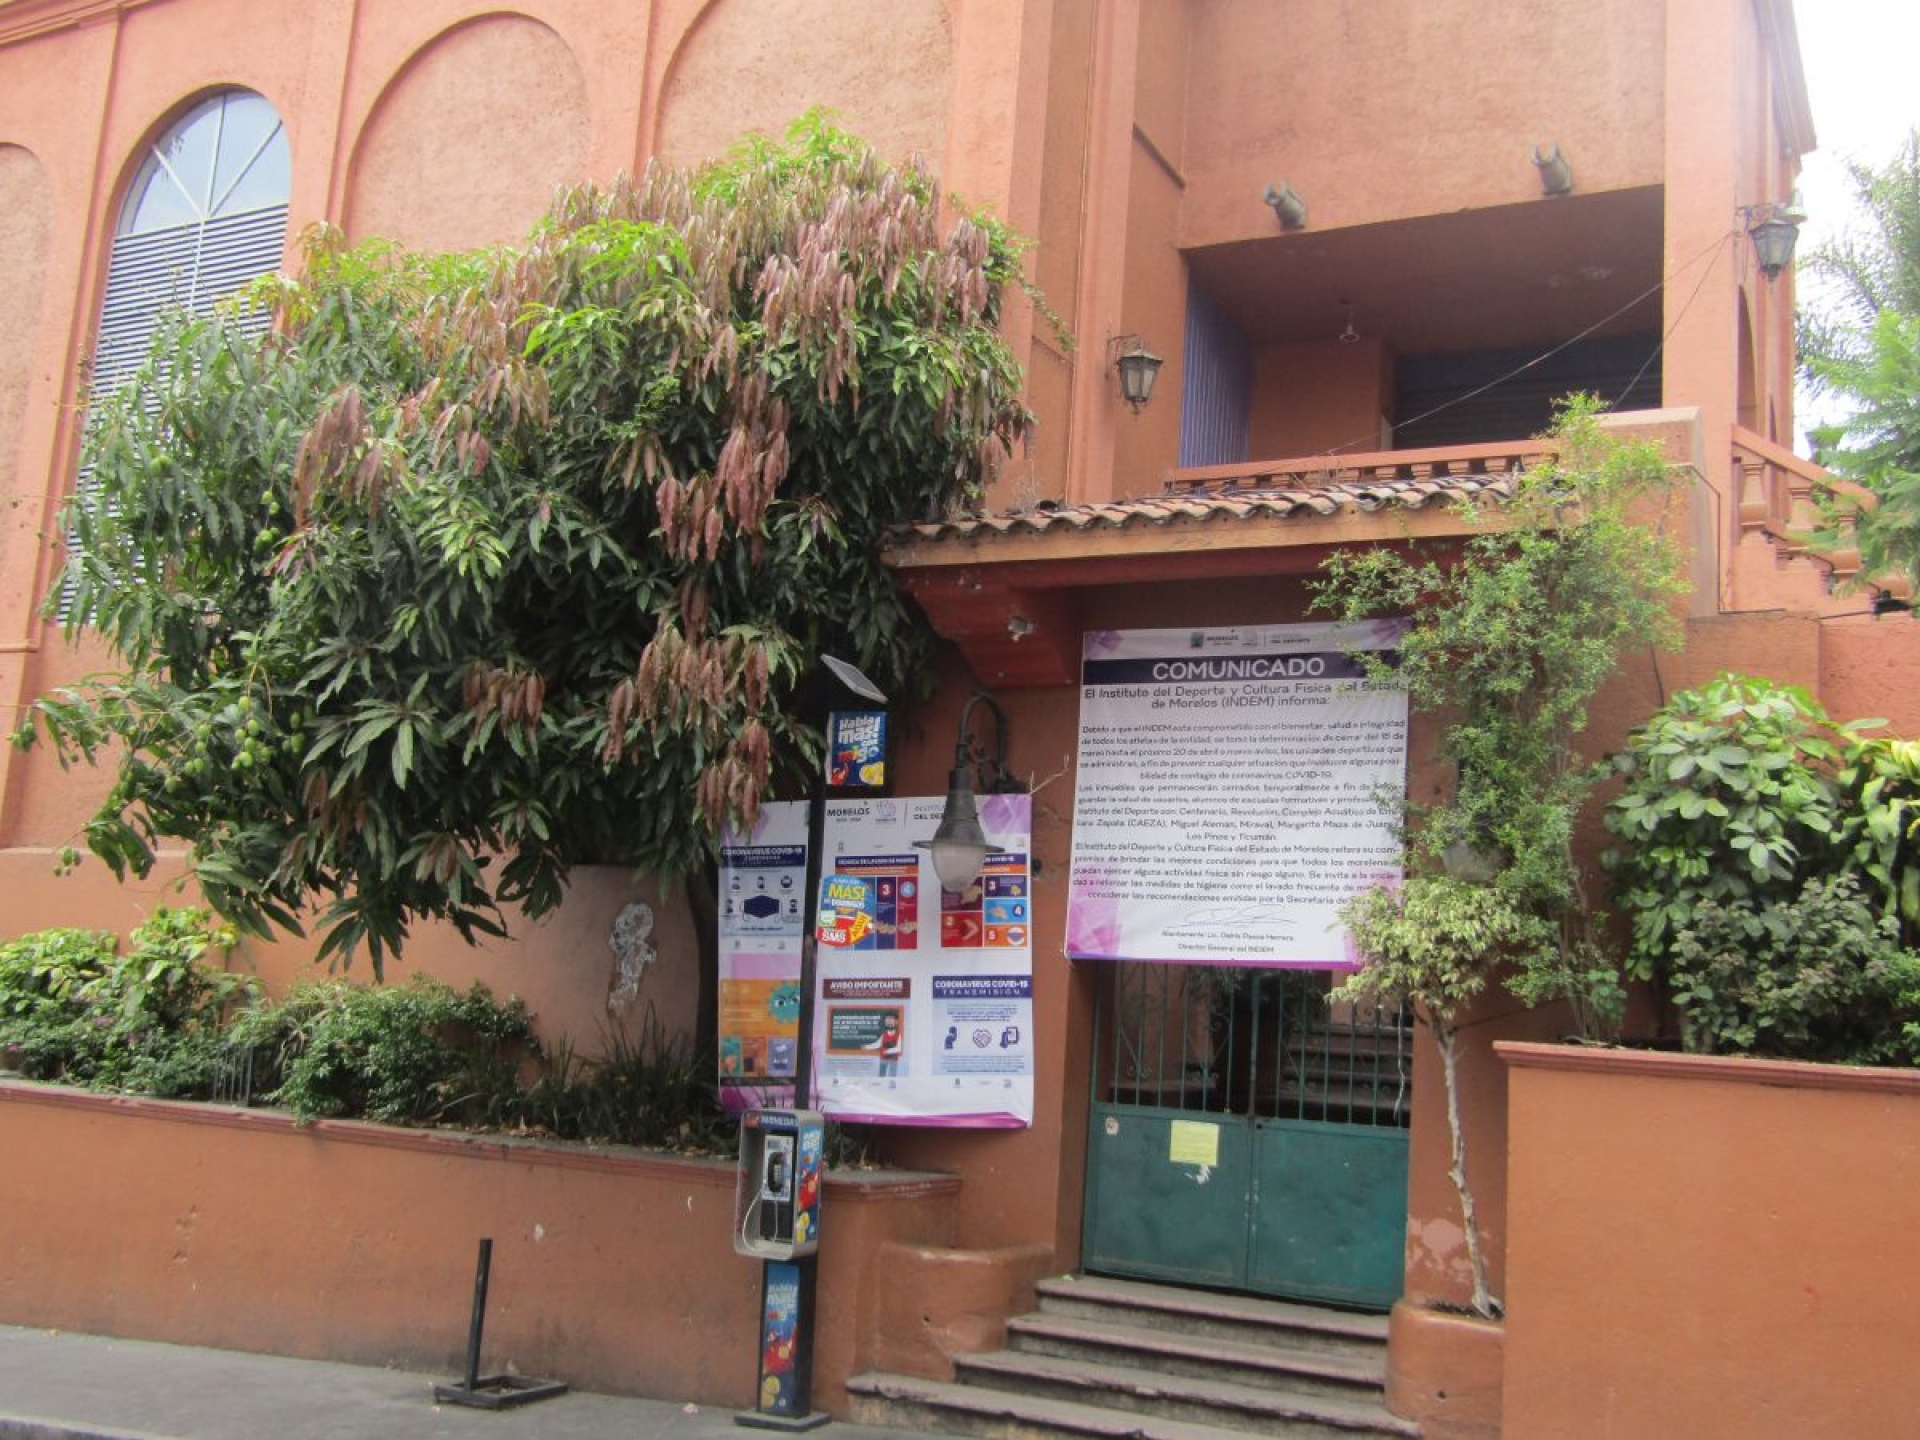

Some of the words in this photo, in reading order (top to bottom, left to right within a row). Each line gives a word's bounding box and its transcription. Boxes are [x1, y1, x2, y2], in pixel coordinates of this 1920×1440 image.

[1152, 657, 1326, 680] COMUNICADO
[1084, 688, 1096, 699] El
[1098, 686, 1150, 699] Instituto
[1152, 685, 1171, 697] del
[1174, 685, 1226, 699] Deporte
[1230, 687, 1239, 696] y
[1242, 683, 1290, 695] Cultura
[1151, 699, 1169, 710] de
[1170, 697, 1218, 708] Morelos
[1221, 695, 1275, 708] (INDEM)
[1278, 693, 1332, 706] informa:
[882, 884, 890, 896] 3
[935, 980, 991, 988] CORONAVIRUS
[992, 979, 1028, 988] COVID-19
